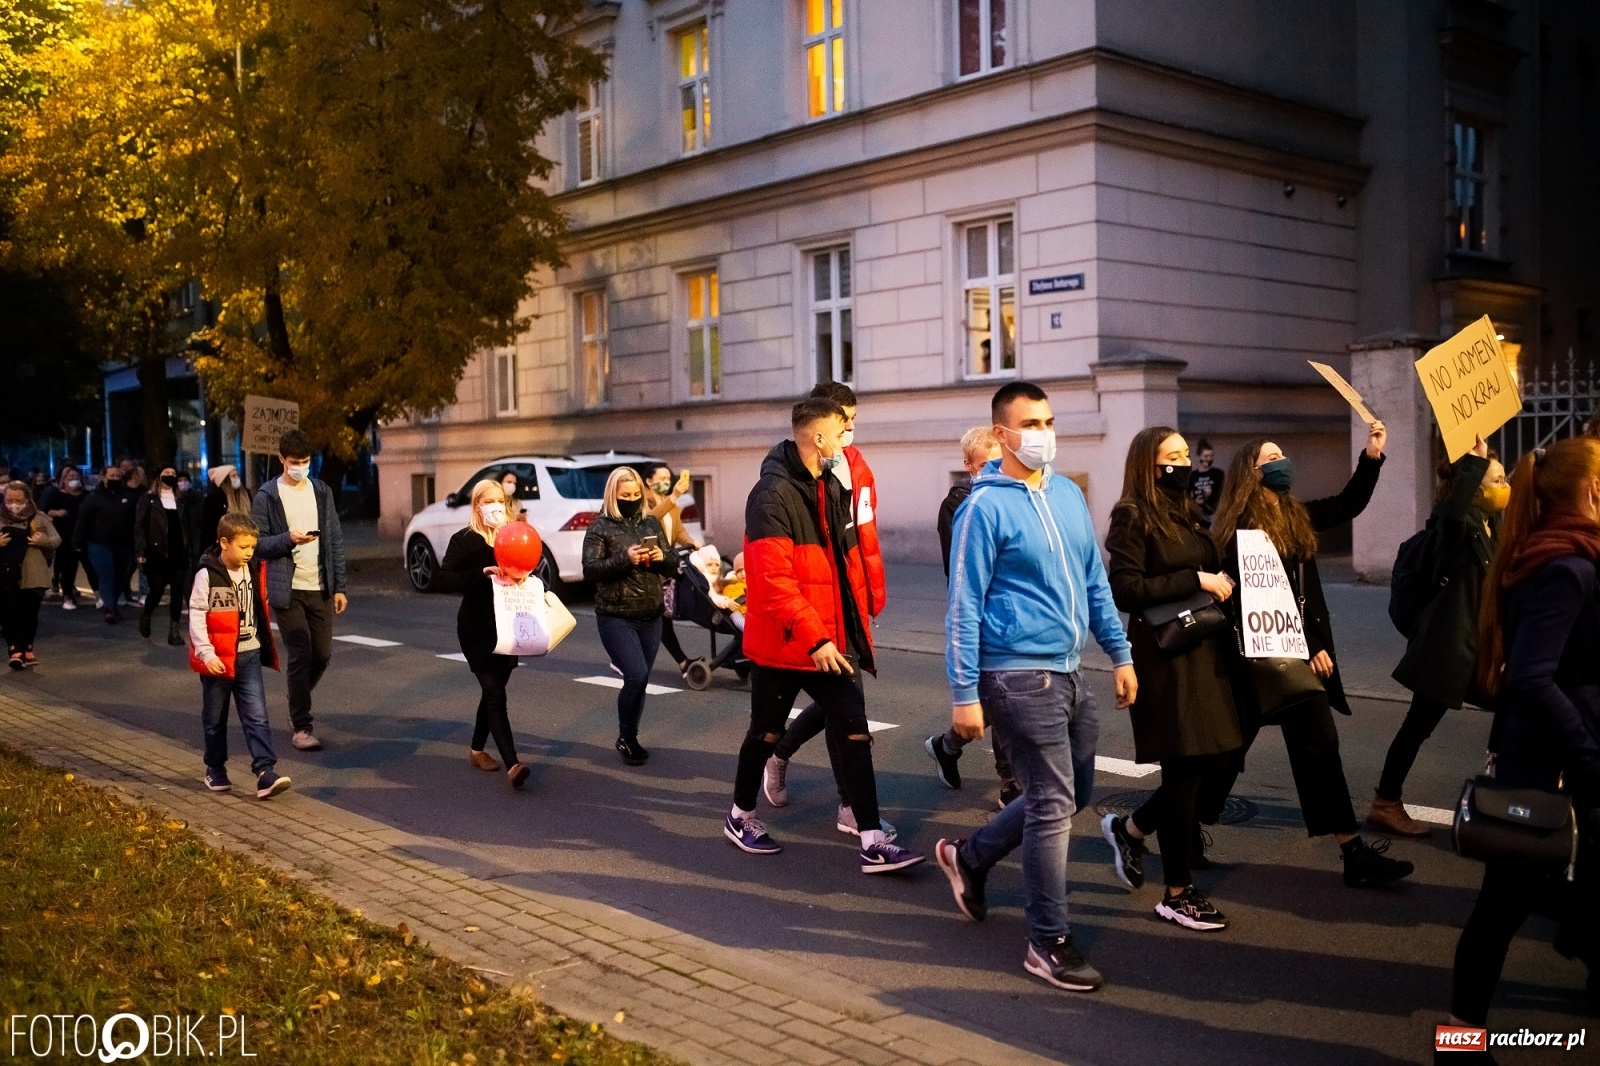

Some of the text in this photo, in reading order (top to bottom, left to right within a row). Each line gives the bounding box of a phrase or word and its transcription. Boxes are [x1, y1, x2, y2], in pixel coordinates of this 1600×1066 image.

[1429, 333, 1497, 395] NO WOMEN
[1450, 371, 1501, 425] NO KRAJ
[1247, 609, 1302, 635] ODDAĆ
[1252, 635, 1274, 653] NIE
